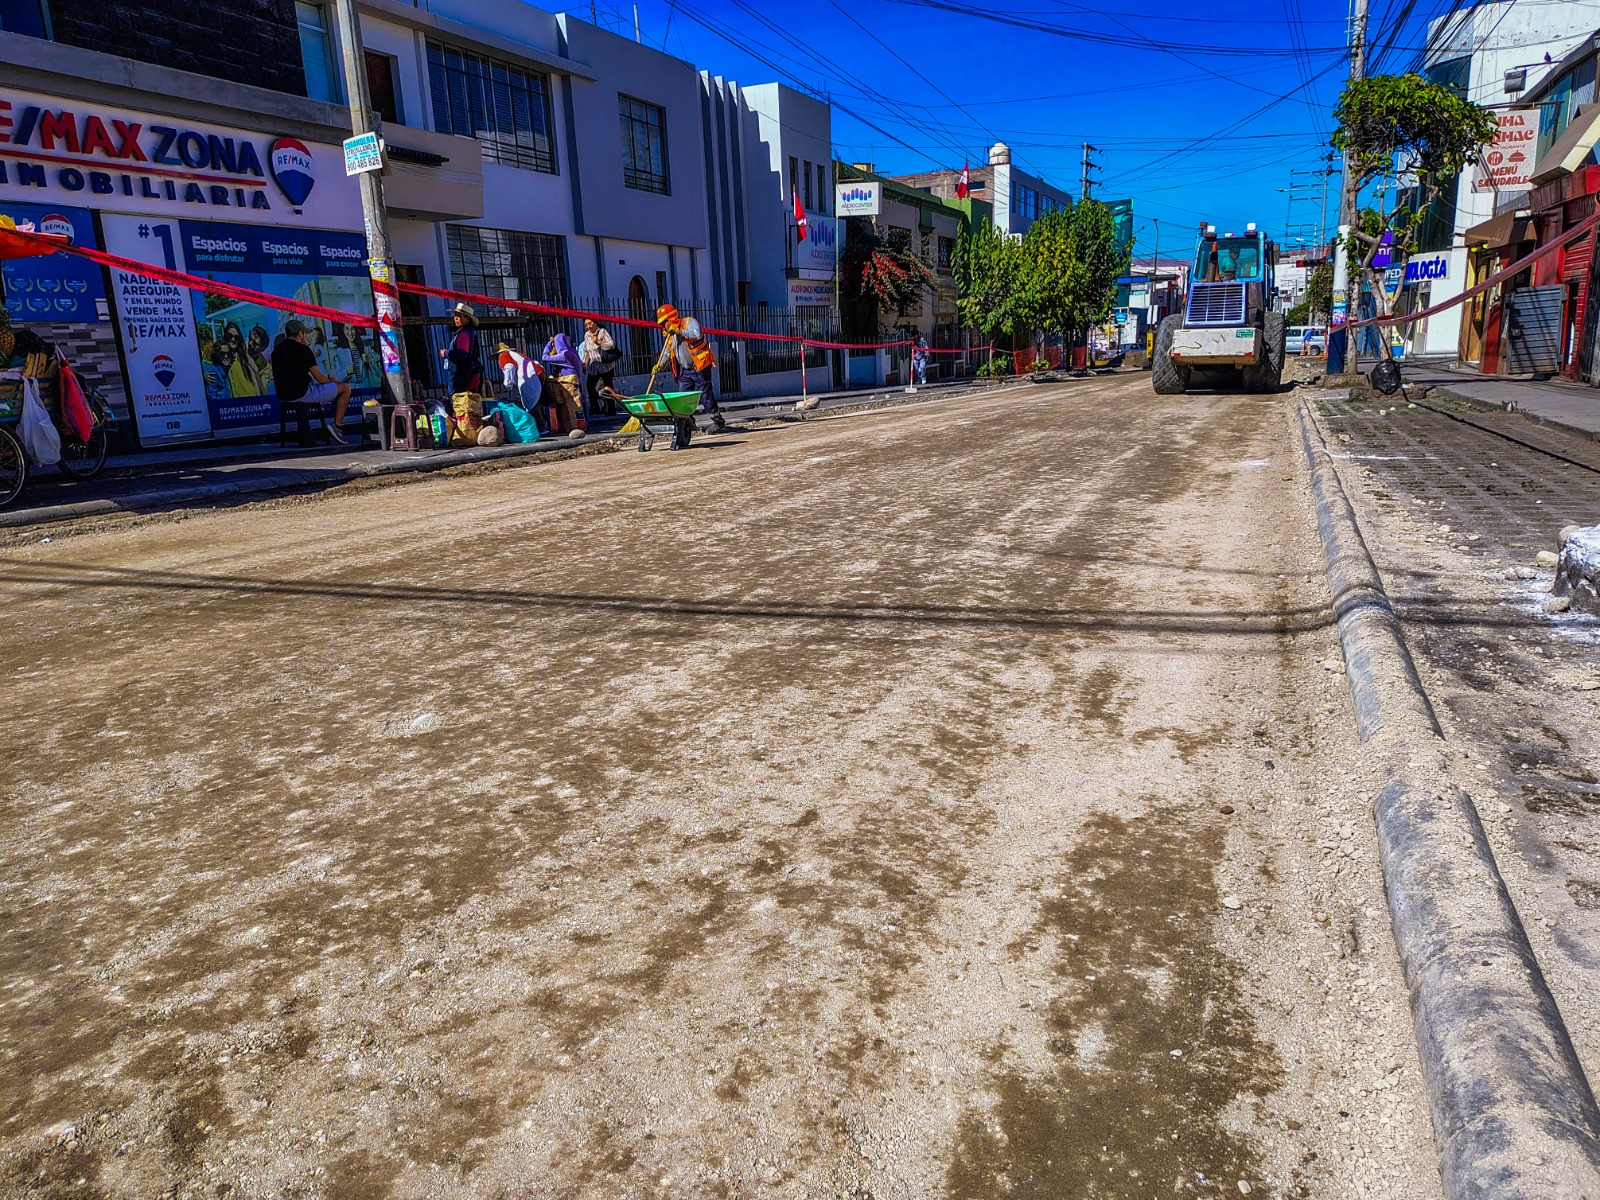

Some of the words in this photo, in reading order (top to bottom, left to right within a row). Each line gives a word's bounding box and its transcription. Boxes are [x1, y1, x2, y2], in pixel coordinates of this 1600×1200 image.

[150, 125, 265, 177] ZONA
[278, 154, 310, 170] RE/MAX
[1491, 163, 1518, 176] MENÚ
[0, 160, 271, 210] MOBILIARIA
[138, 223, 177, 272] #1
[191, 235, 247, 252] Espacios
[262, 241, 309, 256] Espacios
[195, 253, 213, 262] para
[214, 253, 244, 262] disfrutar
[320, 245, 361, 259] Espacios
[811, 250, 837, 260] AUDIOCENTE
[273, 257, 288, 265] para
[325, 260, 339, 268] para
[119, 273, 160, 285] NADIE
[122, 285, 181, 296] AREQUIPA
[123, 297, 129, 305] Y
[131, 297, 142, 305] EN
[144, 297, 153, 305] EL
[125, 307, 159, 316] VENDE
[163, 305, 184, 316] MÁS
[128, 324, 187, 338] RE/MAX
[144, 394, 171, 402] RE/MAX
[172, 392, 191, 400] ZONA
[245, 404, 263, 413] ZONA
